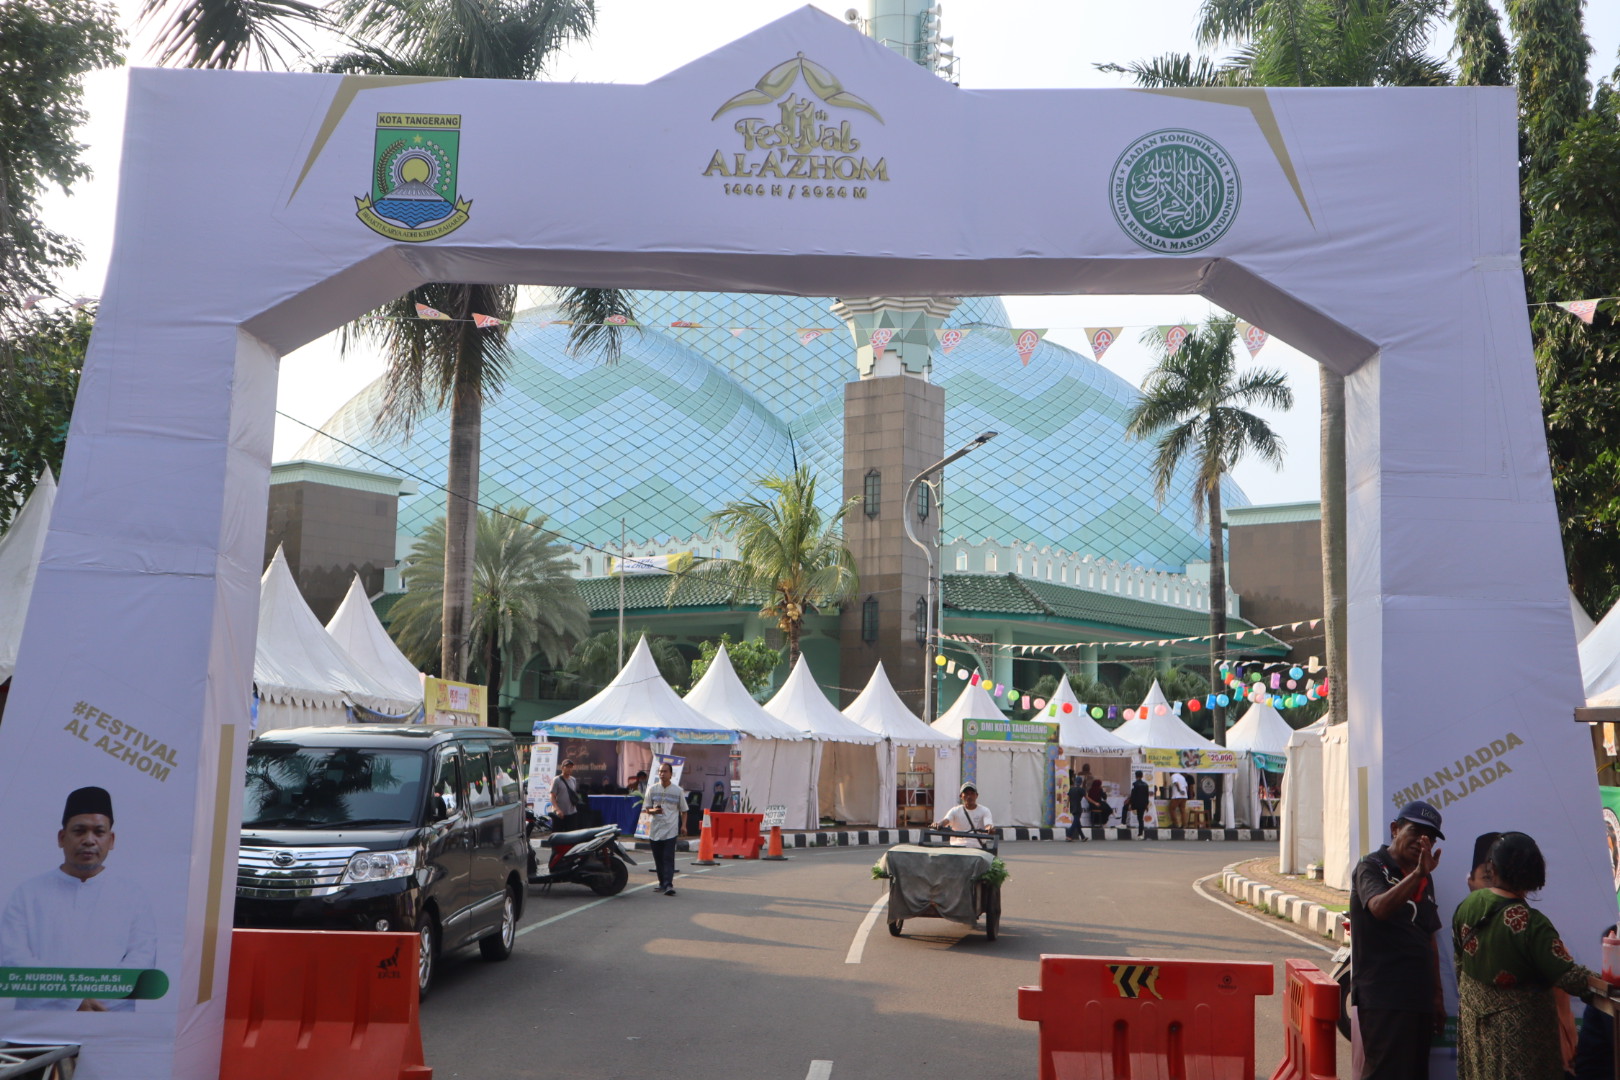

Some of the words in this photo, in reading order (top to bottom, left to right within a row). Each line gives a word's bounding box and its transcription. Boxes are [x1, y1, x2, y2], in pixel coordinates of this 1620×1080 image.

[379, 116, 402, 124] KOTA
[405, 116, 458, 126] TANGERANG
[1123, 138, 1158, 167] BADAN
[1160, 134, 1227, 168] KOMUNIKASI
[724, 183, 765, 196] 1446
[771, 184, 782, 196] H
[788, 185, 796, 200] /
[802, 185, 847, 198] 2024
[853, 186, 868, 199] M
[362, 210, 382, 229] BHAKTI
[382, 225, 402, 237] KARYA
[403, 230, 419, 238] ADHI
[419, 228, 438, 238] KERTA
[438, 214, 464, 235] RAHARJA
[1115, 177, 1130, 221] PEMUDA
[1127, 220, 1167, 249] REMAJA
[1170, 233, 1211, 249] MASJID
[1210, 177, 1235, 235] INDONESIA
[72, 701, 178, 768] #FESTIVAL
[981, 722, 994, 731] DMI
[994, 723, 1010, 732] KOTA
[1012, 723, 1048, 734] TANGERANG
[63, 718, 90, 742] AL
[93, 735, 171, 783] AZHOM
[1392, 732, 1524, 809] #MANJADDA
[9, 973, 22, 981] Dr.
[25, 973, 66, 983] NURDIN,
[11, 983, 37, 991] WALI
[70, 984, 133, 993] TANGERANG
